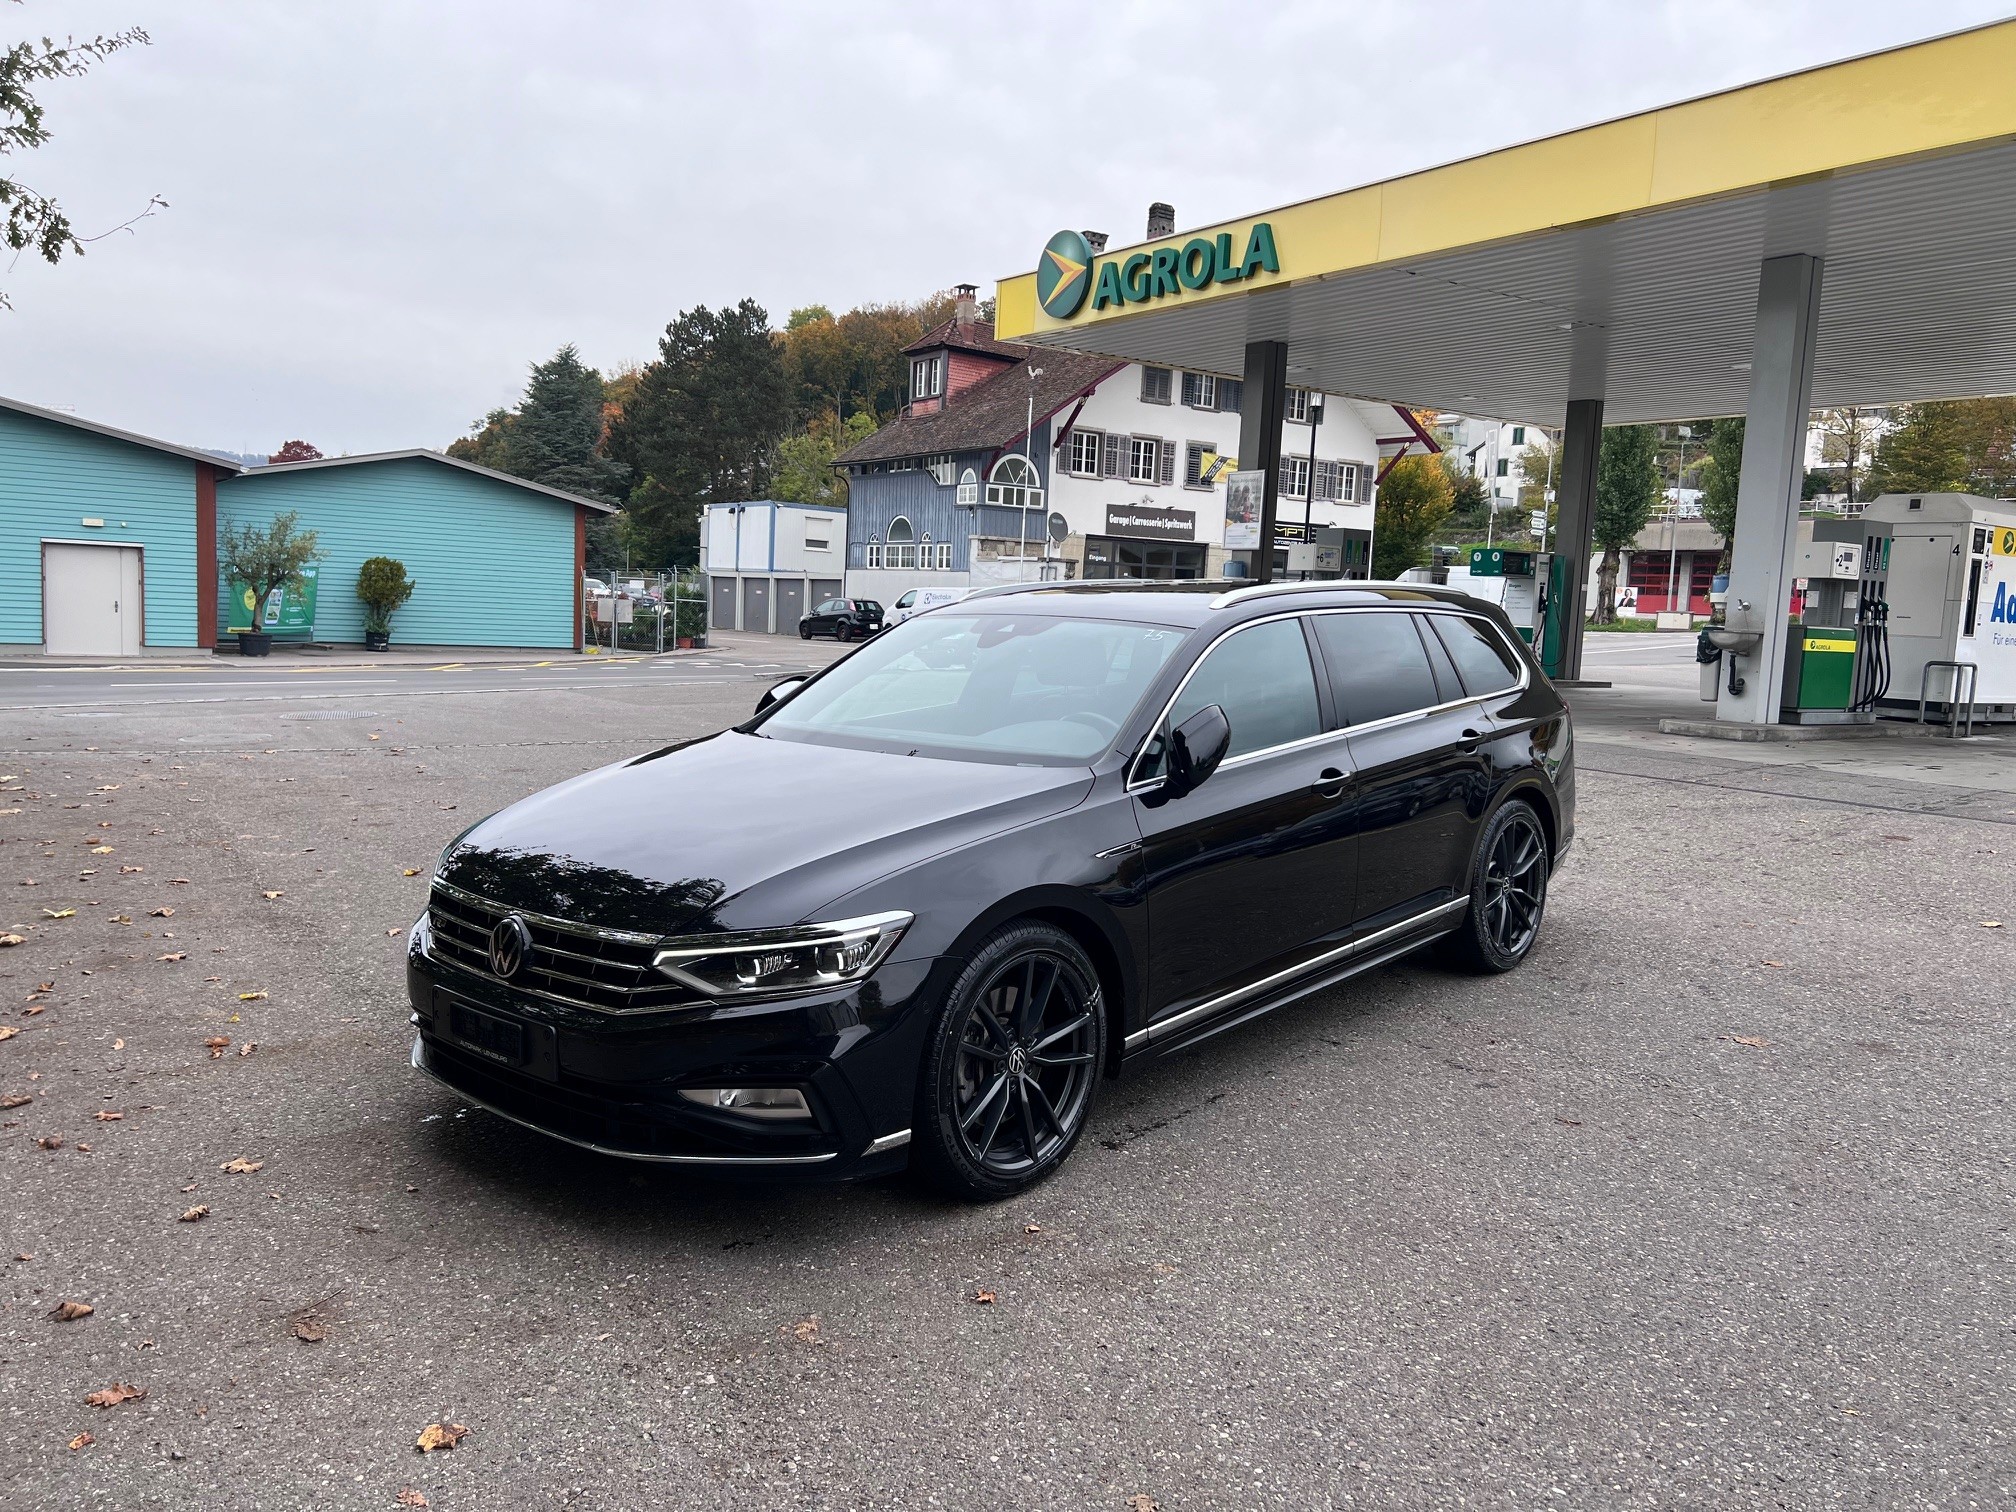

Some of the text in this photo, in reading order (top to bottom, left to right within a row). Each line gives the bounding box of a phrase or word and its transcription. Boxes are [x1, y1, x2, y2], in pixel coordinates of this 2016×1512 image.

[1091, 222, 1279, 310] AGROLA
[1109, 513, 1193, 530] Garage Carrosserie Spritzwerk
[1952, 544, 1961, 557] 4
[1088, 554, 1107, 562] Eingang
[1838, 554, 1844, 567] 2
[1143, 629, 1172, 641] 75
[1992, 632, 2004, 646] Für
